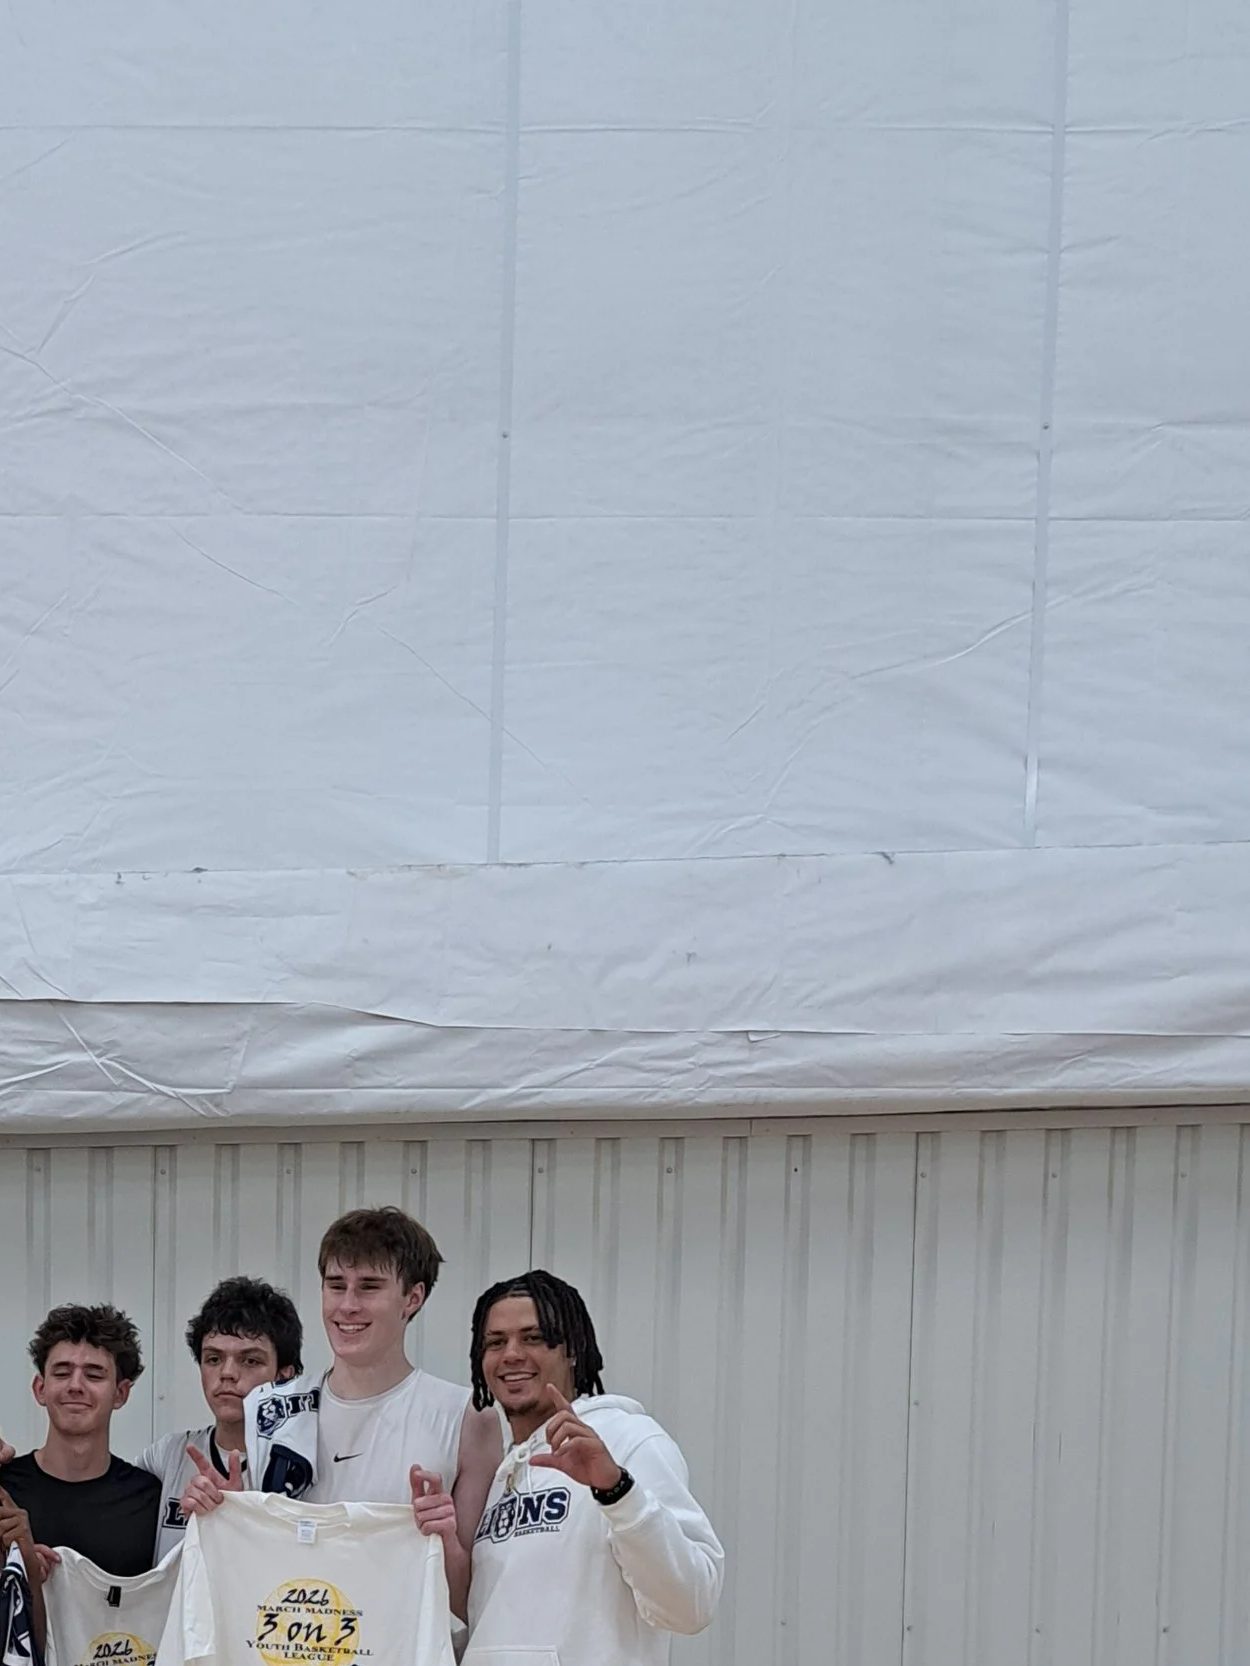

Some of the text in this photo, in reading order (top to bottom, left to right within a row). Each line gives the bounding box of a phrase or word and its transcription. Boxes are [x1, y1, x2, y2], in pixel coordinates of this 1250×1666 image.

[281, 1588, 330, 1606] 2026
[257, 1604, 364, 1616] MARCH MADNESS
[258, 1613, 358, 1646] 3 on 3
[93, 1639, 133, 1660] 2026
[284, 1651, 335, 1662] LEAGUE
[295, 1643, 374, 1656] BASKETBALL
